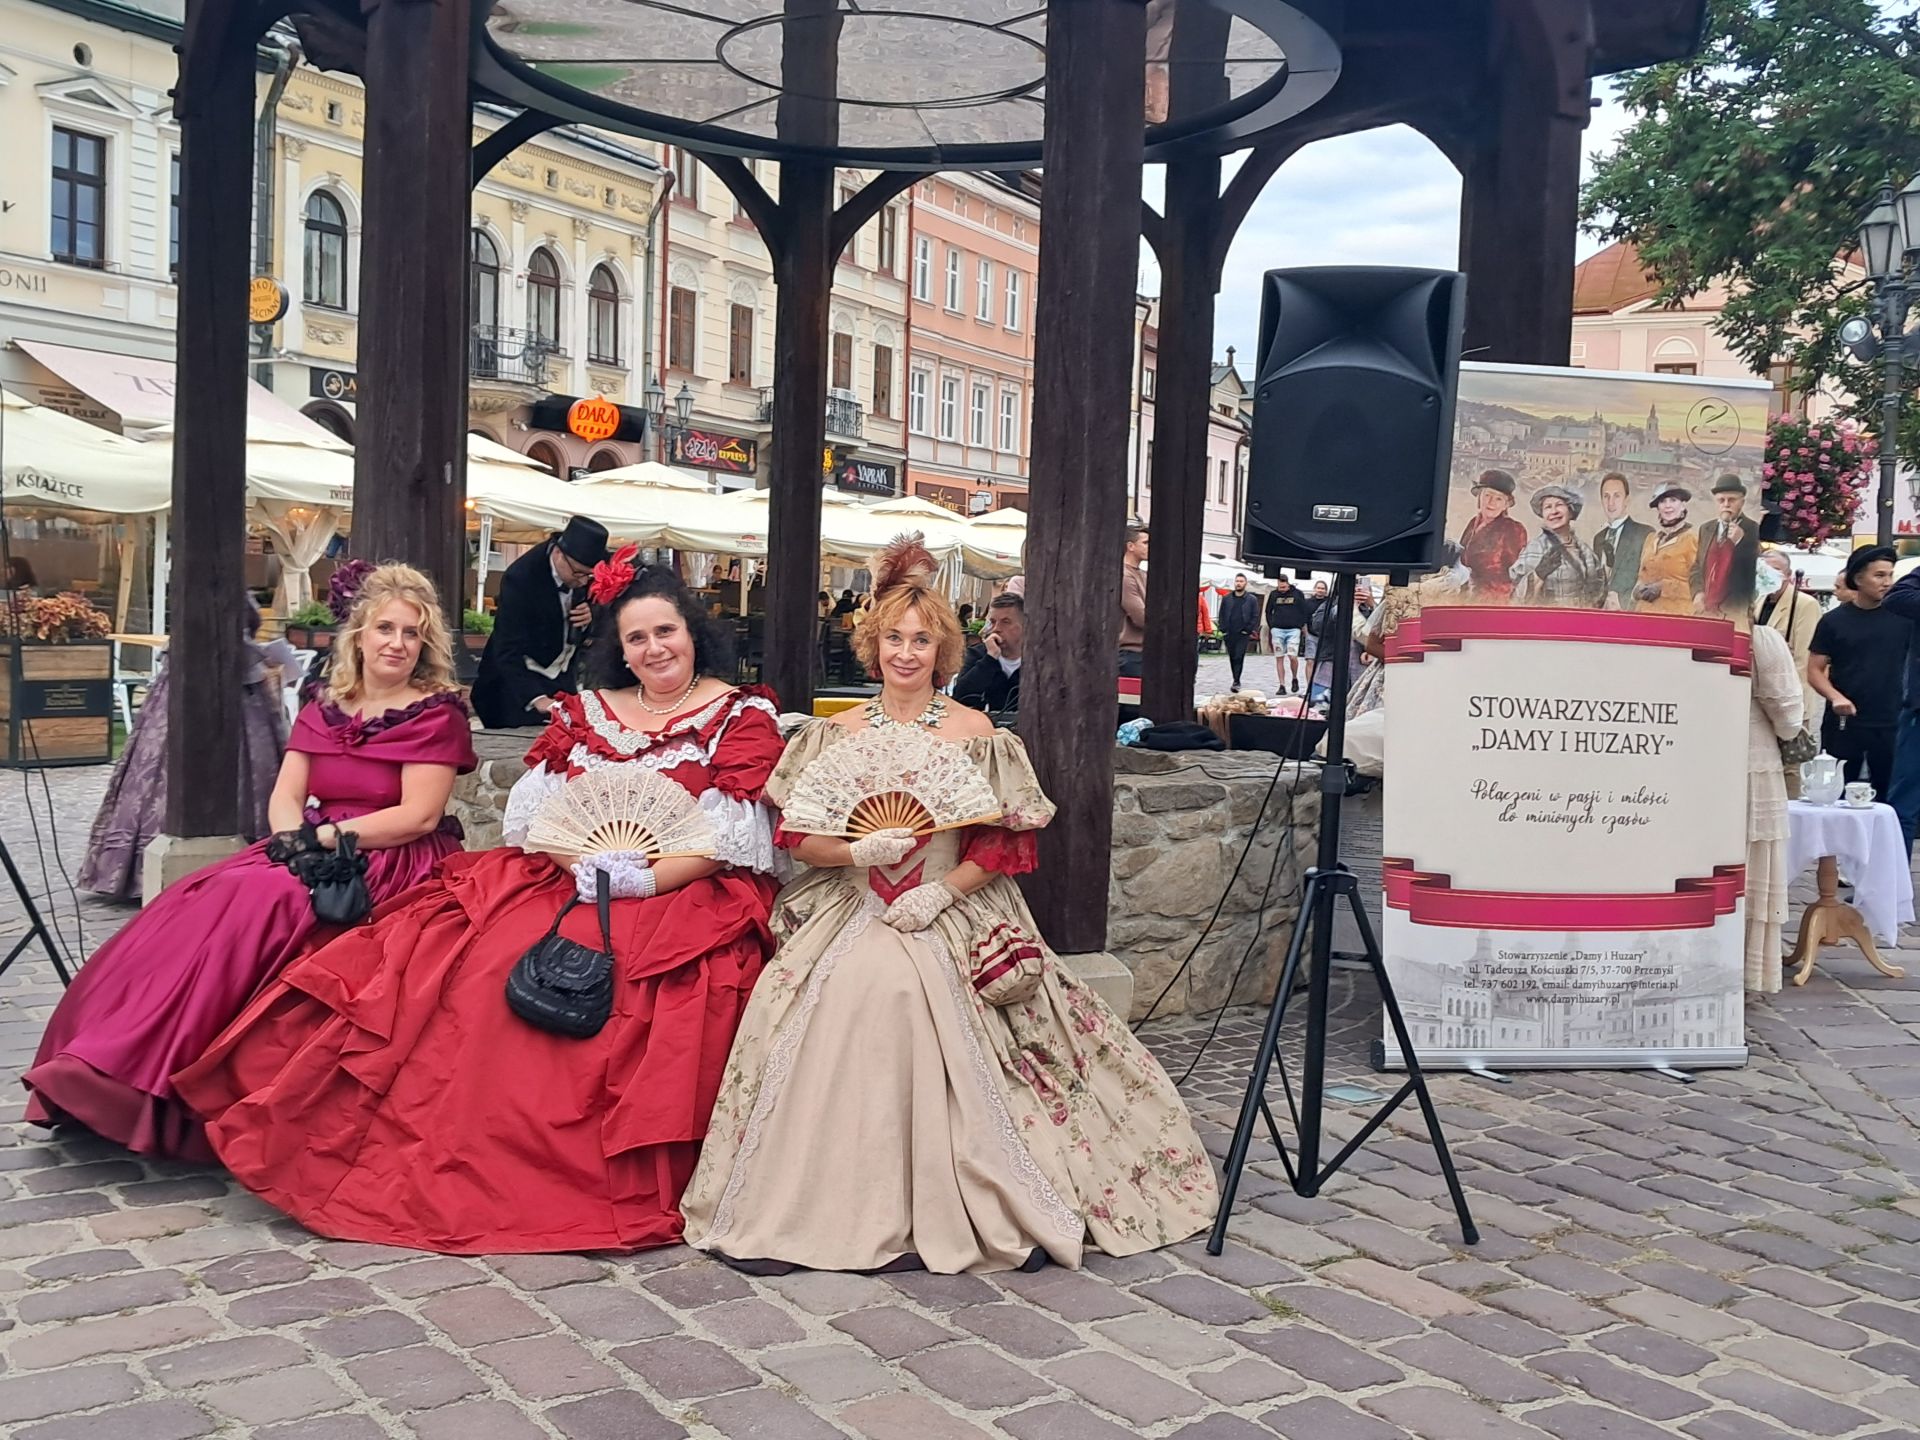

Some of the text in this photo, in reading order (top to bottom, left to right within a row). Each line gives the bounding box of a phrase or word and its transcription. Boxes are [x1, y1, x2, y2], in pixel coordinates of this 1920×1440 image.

[577, 403, 615, 425] DARA
[16, 474, 84, 498] KSIĄŻĘCE
[1468, 695, 1678, 725] STOWARZYSZENIE
[1560, 731, 1567, 752] I
[1470, 779, 1670, 812] Połączeni w pasji i miłości
[1499, 804, 1651, 834] do minionych czasów
[1498, 950, 1568, 962] Stowarzyszenie
[1469, 964, 1674, 978] ul. Tadeusza Kościuszki 7/5, 37-700 Przemyśl
[1464, 979, 1478, 989] tel.
[1481, 979, 1498, 989] 737
[1501, 980, 1518, 989] 602
[1542, 980, 1570, 990] email:
[1572, 979, 1678, 991] damyihuzary@interia.pl
[1526, 993, 1620, 1006] www.damyihuzary.pl
